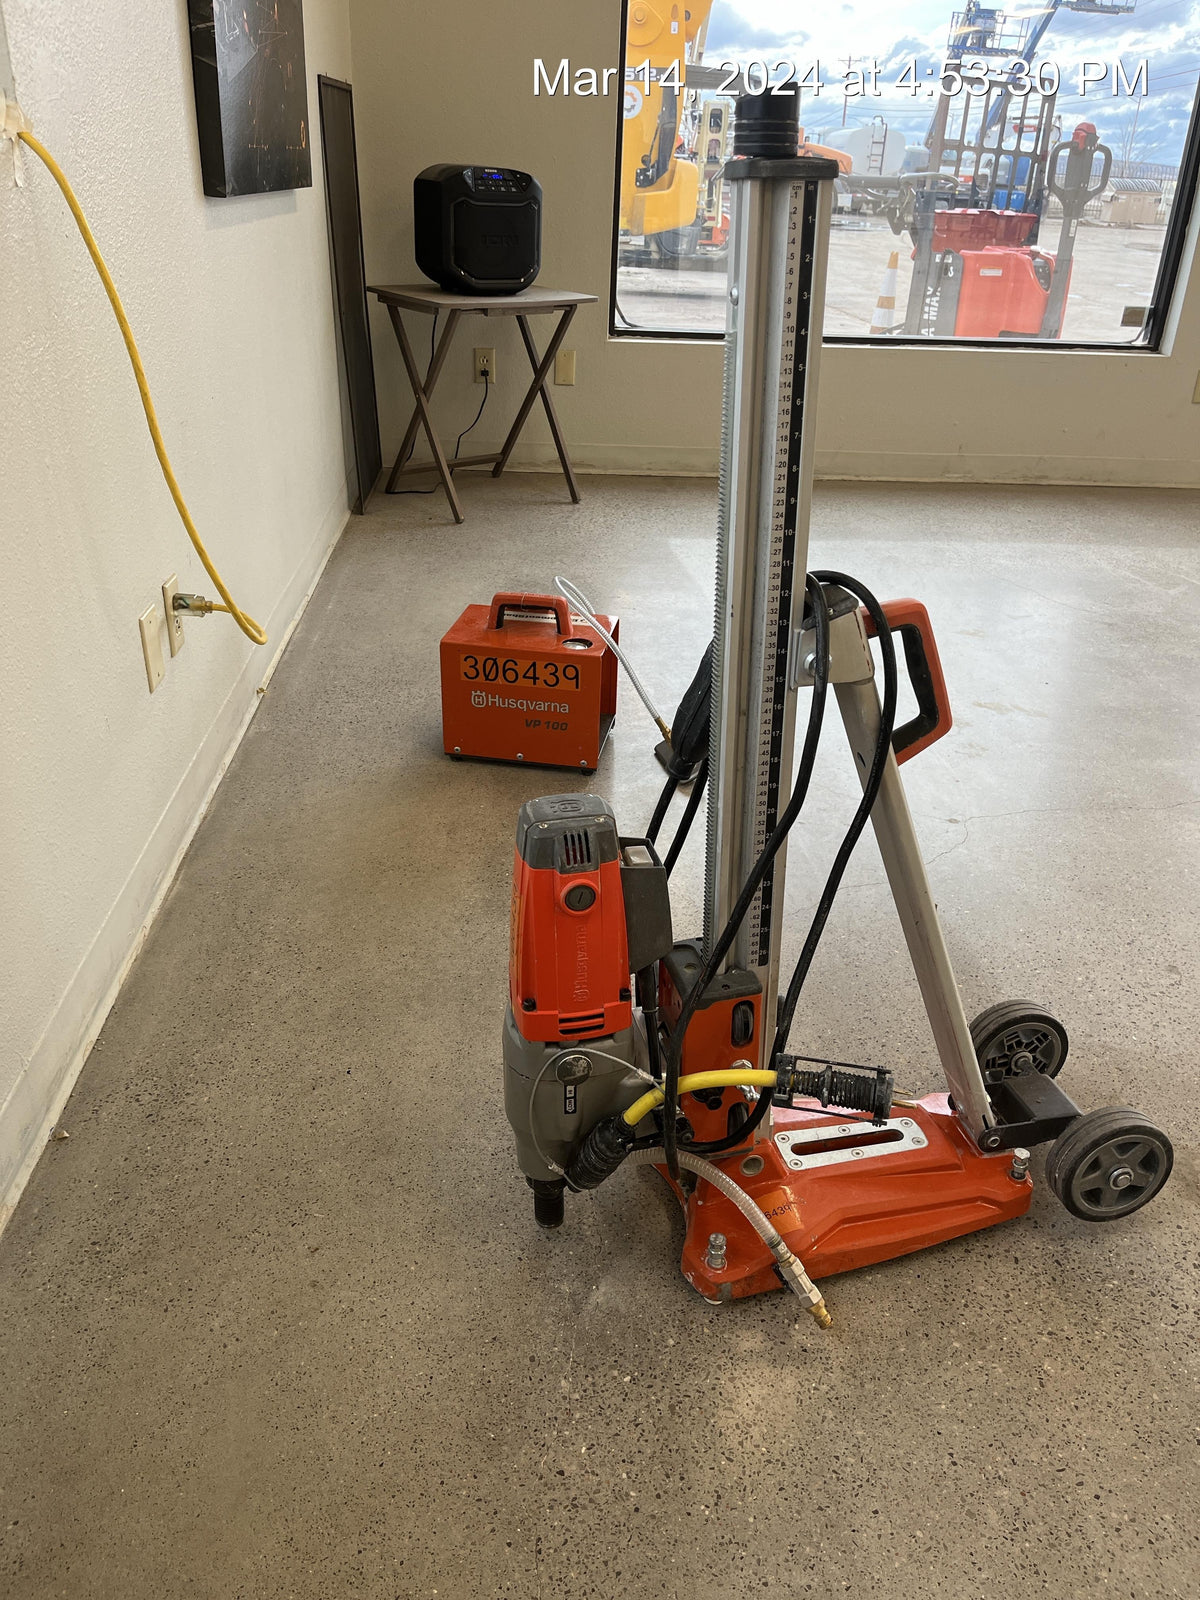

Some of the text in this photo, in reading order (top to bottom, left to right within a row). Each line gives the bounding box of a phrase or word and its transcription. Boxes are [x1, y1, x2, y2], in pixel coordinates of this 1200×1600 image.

[463, 654, 580, 690] 306439
[488, 693, 569, 714] Husqvarna
[525, 719, 569, 731] VP 100
[764, 1204, 792, 1220] 6439
